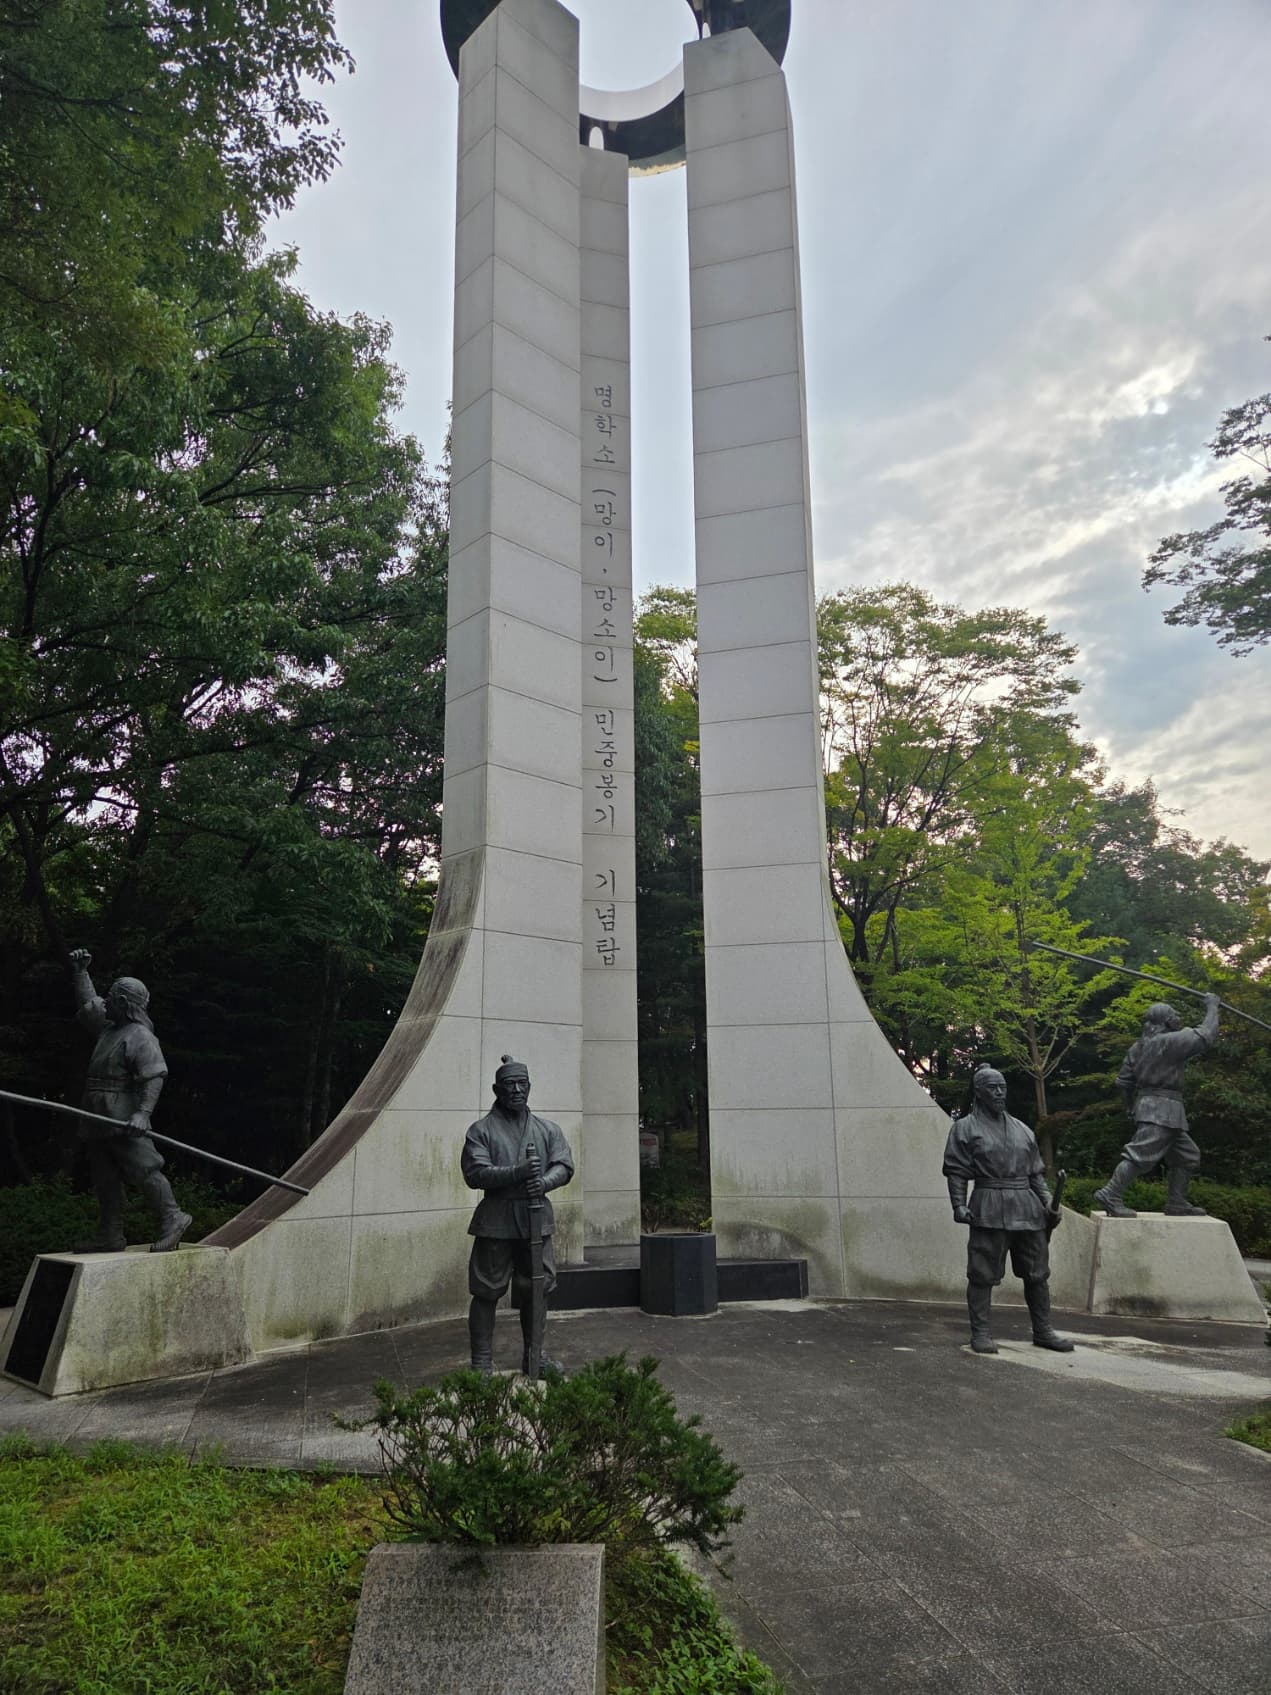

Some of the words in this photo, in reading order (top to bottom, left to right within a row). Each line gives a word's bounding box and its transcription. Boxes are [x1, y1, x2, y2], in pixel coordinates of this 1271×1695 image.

[593, 384, 617, 464] 명학소
[595, 709, 618, 832] 민중봉기
[595, 869, 621, 967] 기념탑
